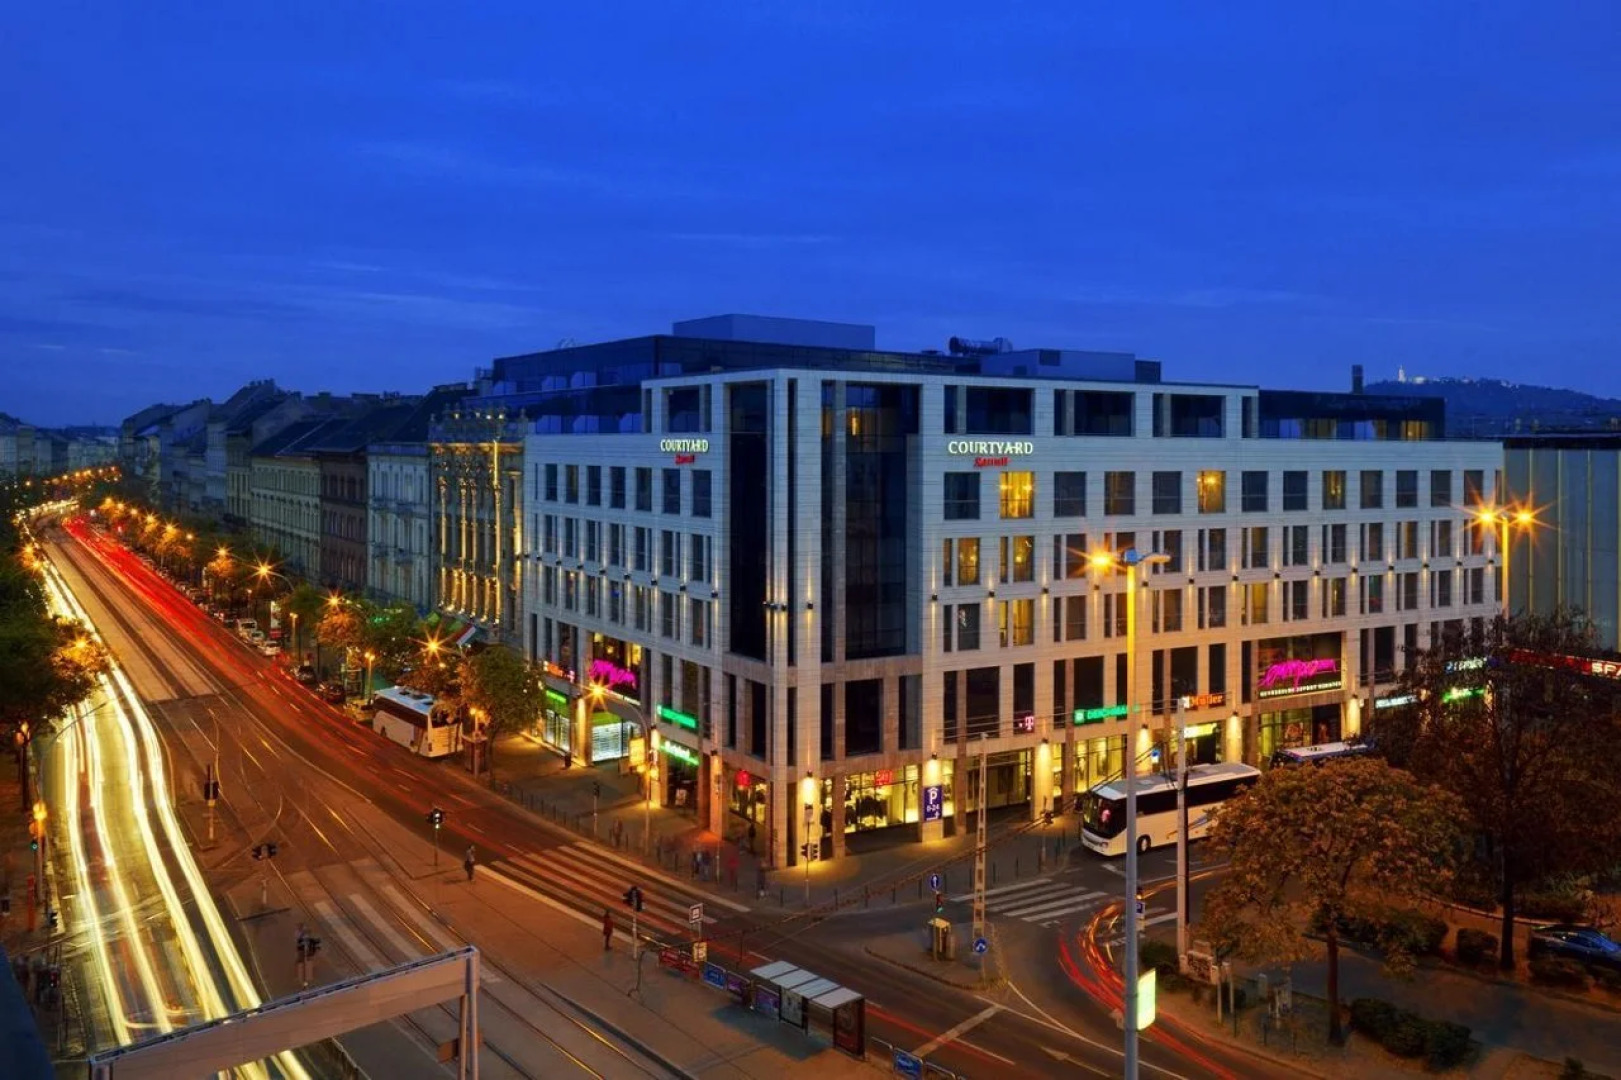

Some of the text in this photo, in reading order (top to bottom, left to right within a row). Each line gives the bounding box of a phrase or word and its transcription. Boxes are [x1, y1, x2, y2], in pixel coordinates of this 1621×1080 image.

[660, 438, 709, 453] COURTYARD
[948, 441, 1033, 454] COURTYARD
[929, 790, 938, 805] P
